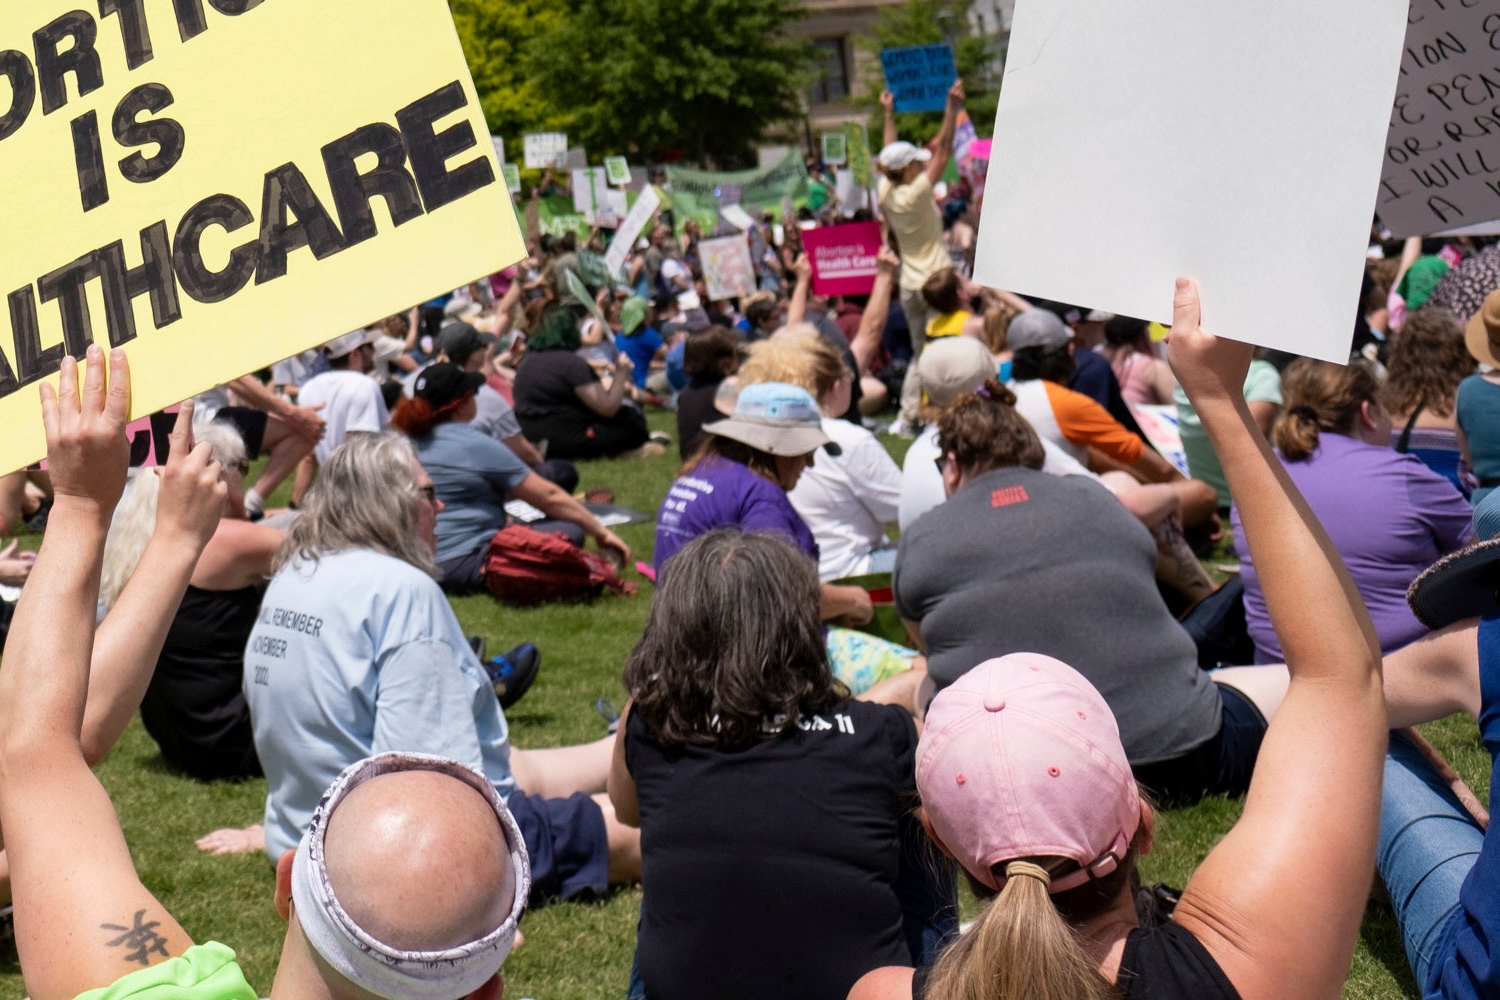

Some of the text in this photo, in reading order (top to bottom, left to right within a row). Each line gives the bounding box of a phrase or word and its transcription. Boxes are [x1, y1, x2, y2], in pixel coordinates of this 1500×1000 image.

[1400, 30, 1467, 76] ION
[71, 82, 186, 213] IS
[1410, 149, 1500, 189] WILL
[817, 257, 851, 270] Health
[271, 607, 324, 638] REMEMBER
